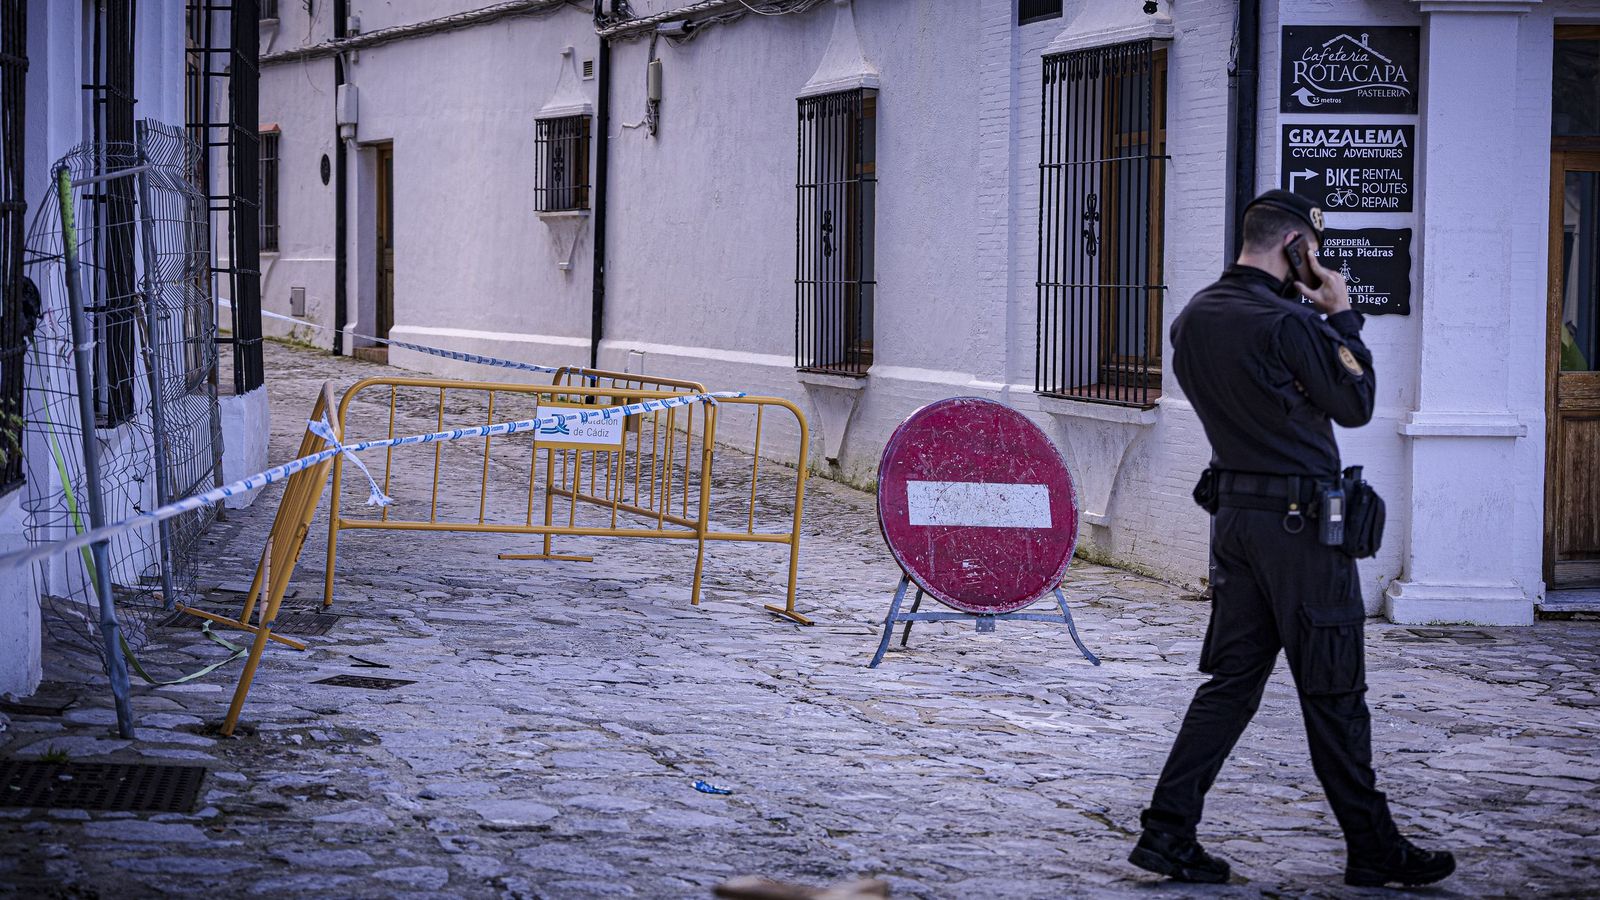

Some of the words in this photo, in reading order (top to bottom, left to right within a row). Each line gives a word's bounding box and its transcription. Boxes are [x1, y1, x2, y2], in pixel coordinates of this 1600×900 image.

[1302, 45, 1370, 68] Cafetería
[1292, 61, 1409, 84] ROTACAPA
[1289, 129, 1408, 147] GRAZALEMA
[1292, 148, 1337, 158] CYCLING
[1343, 149, 1403, 158] ADVENTURES
[1326, 168, 1360, 187] BIKE
[1362, 169, 1403, 180] RENTAL
[1361, 183, 1408, 194] ROUTES
[1361, 197, 1399, 208] REPAIR
[1323, 248, 1335, 257] de
[1339, 248, 1353, 257] las
[1356, 248, 1394, 257] Piedras
[1357, 294, 1388, 305] Diego
[573, 427, 584, 436] de
[586, 427, 610, 438] Cádiz
